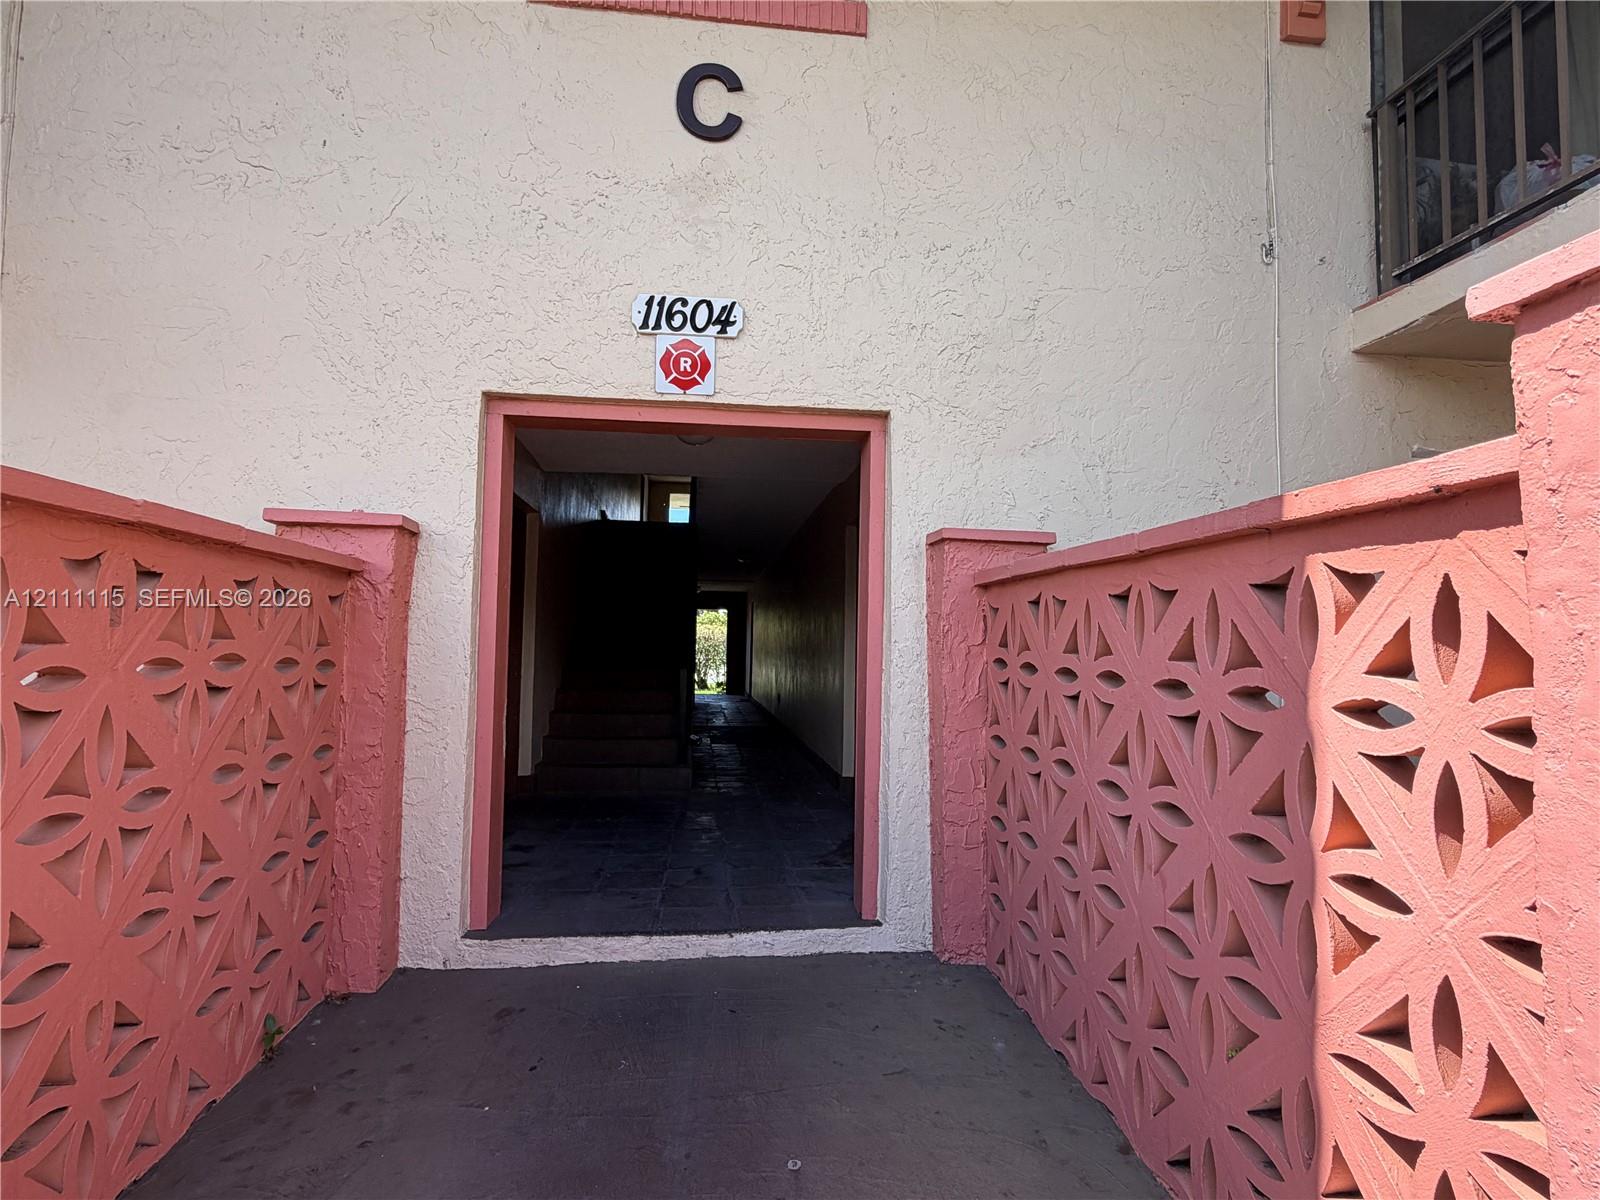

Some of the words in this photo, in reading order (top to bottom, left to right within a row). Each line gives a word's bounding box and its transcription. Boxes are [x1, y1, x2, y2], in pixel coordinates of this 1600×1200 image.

[676, 62, 744, 142] C
[638, 295, 737, 335] 11604
[679, 357, 692, 372] R
